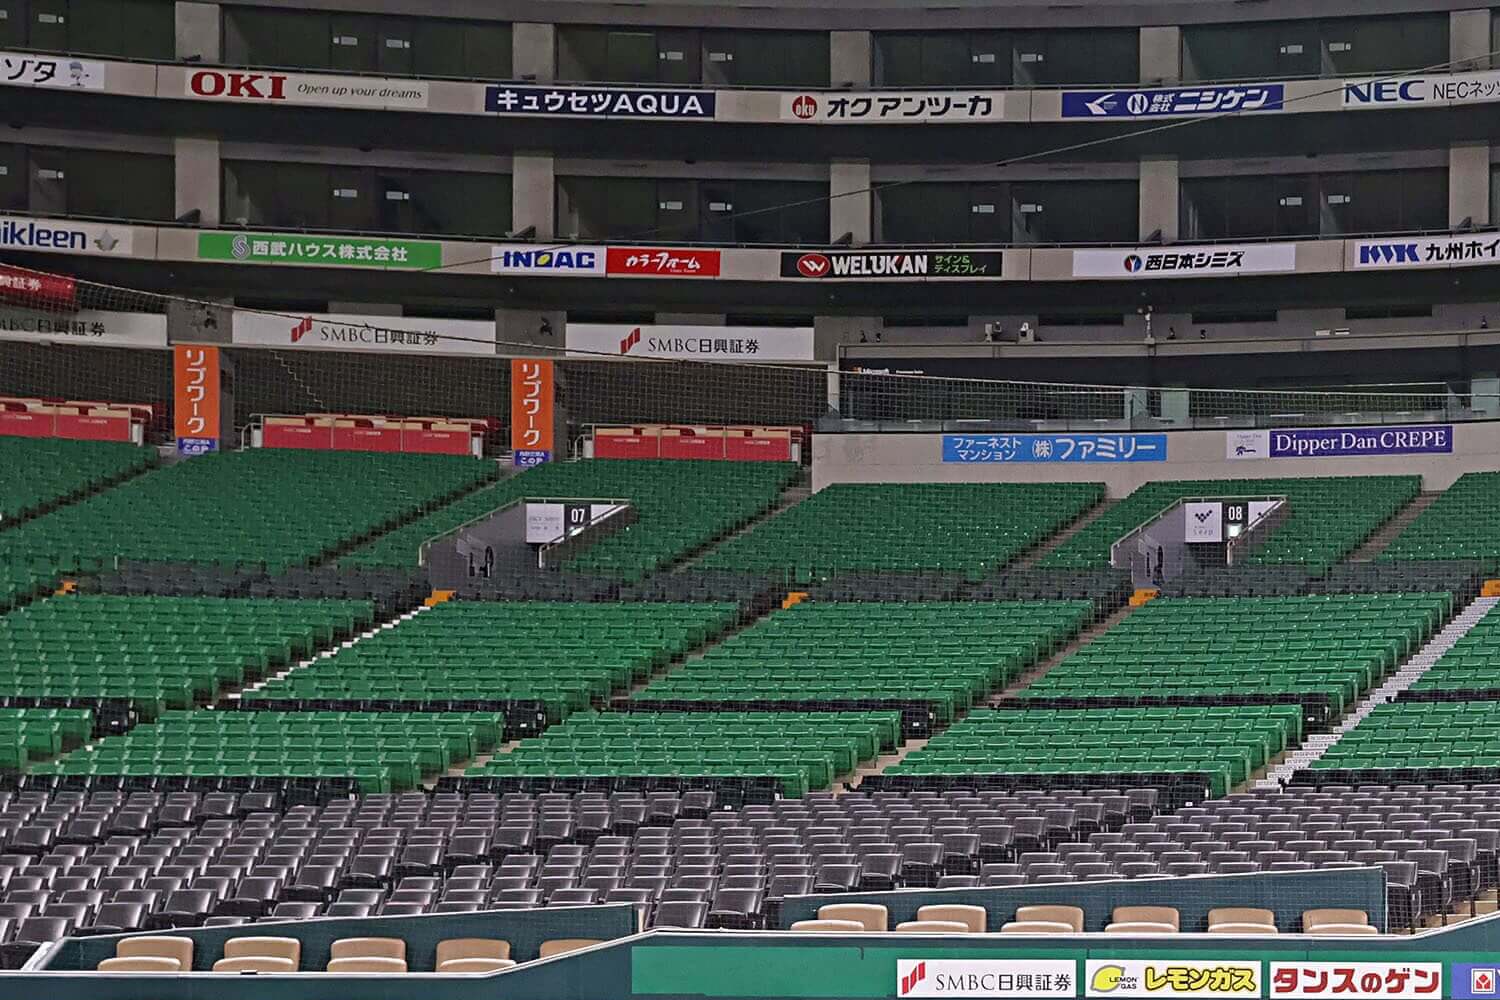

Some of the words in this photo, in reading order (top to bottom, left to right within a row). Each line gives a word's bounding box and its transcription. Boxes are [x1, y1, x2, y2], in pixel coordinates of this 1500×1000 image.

[5, 57, 57, 83] ゾタ
[190, 71, 288, 100] OKI
[297, 83, 329, 96] Open
[331, 87, 347, 97] up
[350, 88, 377, 98] your
[378, 87, 422, 99] dreams
[1344, 79, 1425, 103] NEC
[496, 89, 704, 114] キュウセツAQUA
[827, 96, 993, 118] オクアンツーカ
[1174, 89, 1268, 111] ニシケン
[252, 239, 408, 263] 西武ハウス株式会社
[1144, 251, 1245, 271] 西日本シミズ
[831, 255, 928, 275] WELUKAN
[320, 325, 439, 347] SMBC日興証券
[648, 337, 760, 355] SMBC日興証券
[952, 437, 1023, 450] ファーネスト
[1275, 433, 1336, 455] Dipper
[1339, 432, 1378, 451] Dan
[1380, 431, 1447, 450] CREPE
[957, 449, 1018, 461] マンション
[570, 507, 585, 524] 07
[1227, 505, 1243, 521] 08
[935, 973, 1073, 993] SMBC日興証券
[1144, 967, 1256, 993] レモンガス
[1272, 967, 1441, 995] タンスのゲン
